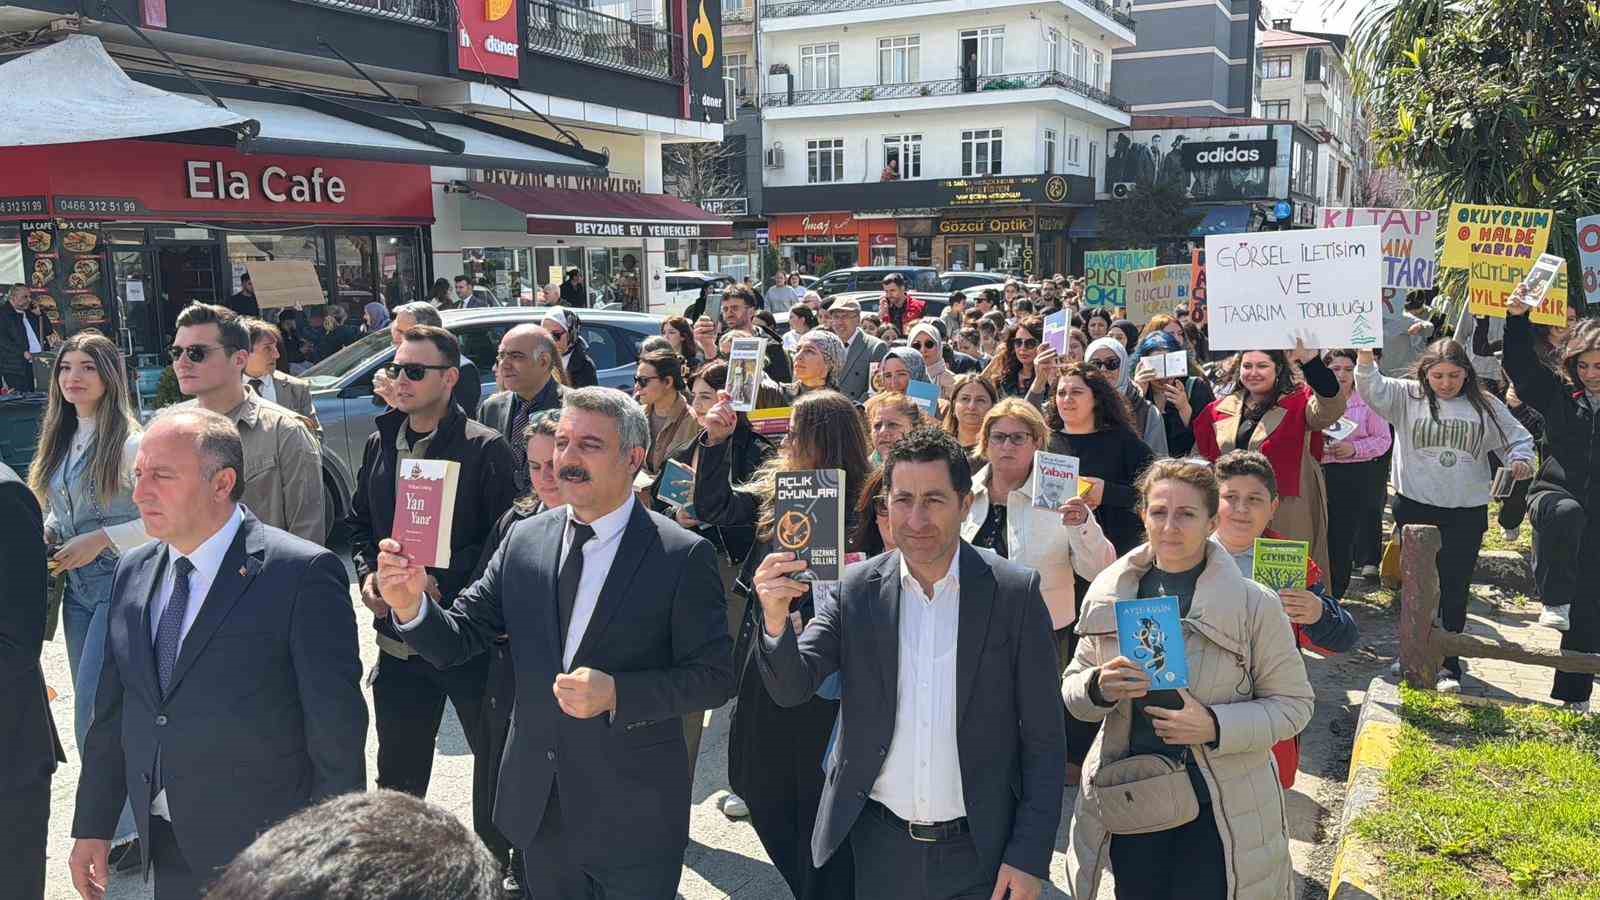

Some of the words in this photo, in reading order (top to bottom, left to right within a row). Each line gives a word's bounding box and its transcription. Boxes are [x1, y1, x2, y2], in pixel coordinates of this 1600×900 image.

[1196, 146, 1259, 164] adidas
[187, 160, 250, 200] Ela
[262, 165, 346, 204] Cafe
[89, 199, 107, 212] 312
[110, 200, 121, 212] 51
[123, 201, 136, 213] 99
[78, 222, 100, 230] CAFE
[940, 219, 985, 233] Gözcü
[990, 218, 1027, 233] Optik
[1457, 207, 1549, 229] OKUYORUM
[575, 222, 624, 236] BEYZADE
[629, 224, 642, 236] EV
[648, 224, 700, 237] YEMEKLERİ
[1457, 226, 1471, 241] O
[1479, 227, 1537, 245] HALDE
[1216, 242, 1291, 272] GÖRSEL
[1471, 243, 1533, 258] VARIM
[1277, 273, 1311, 295] VE
[1218, 304, 1287, 324] TASARIM
[1297, 300, 1373, 320] TOPLULUĞU
[1040, 464, 1074, 480] Yaban
[778, 476, 812, 490] AÇLIK
[406, 491, 425, 511] Yan
[778, 488, 837, 500] OYUNLARI
[811, 557, 837, 565] COLLINS
